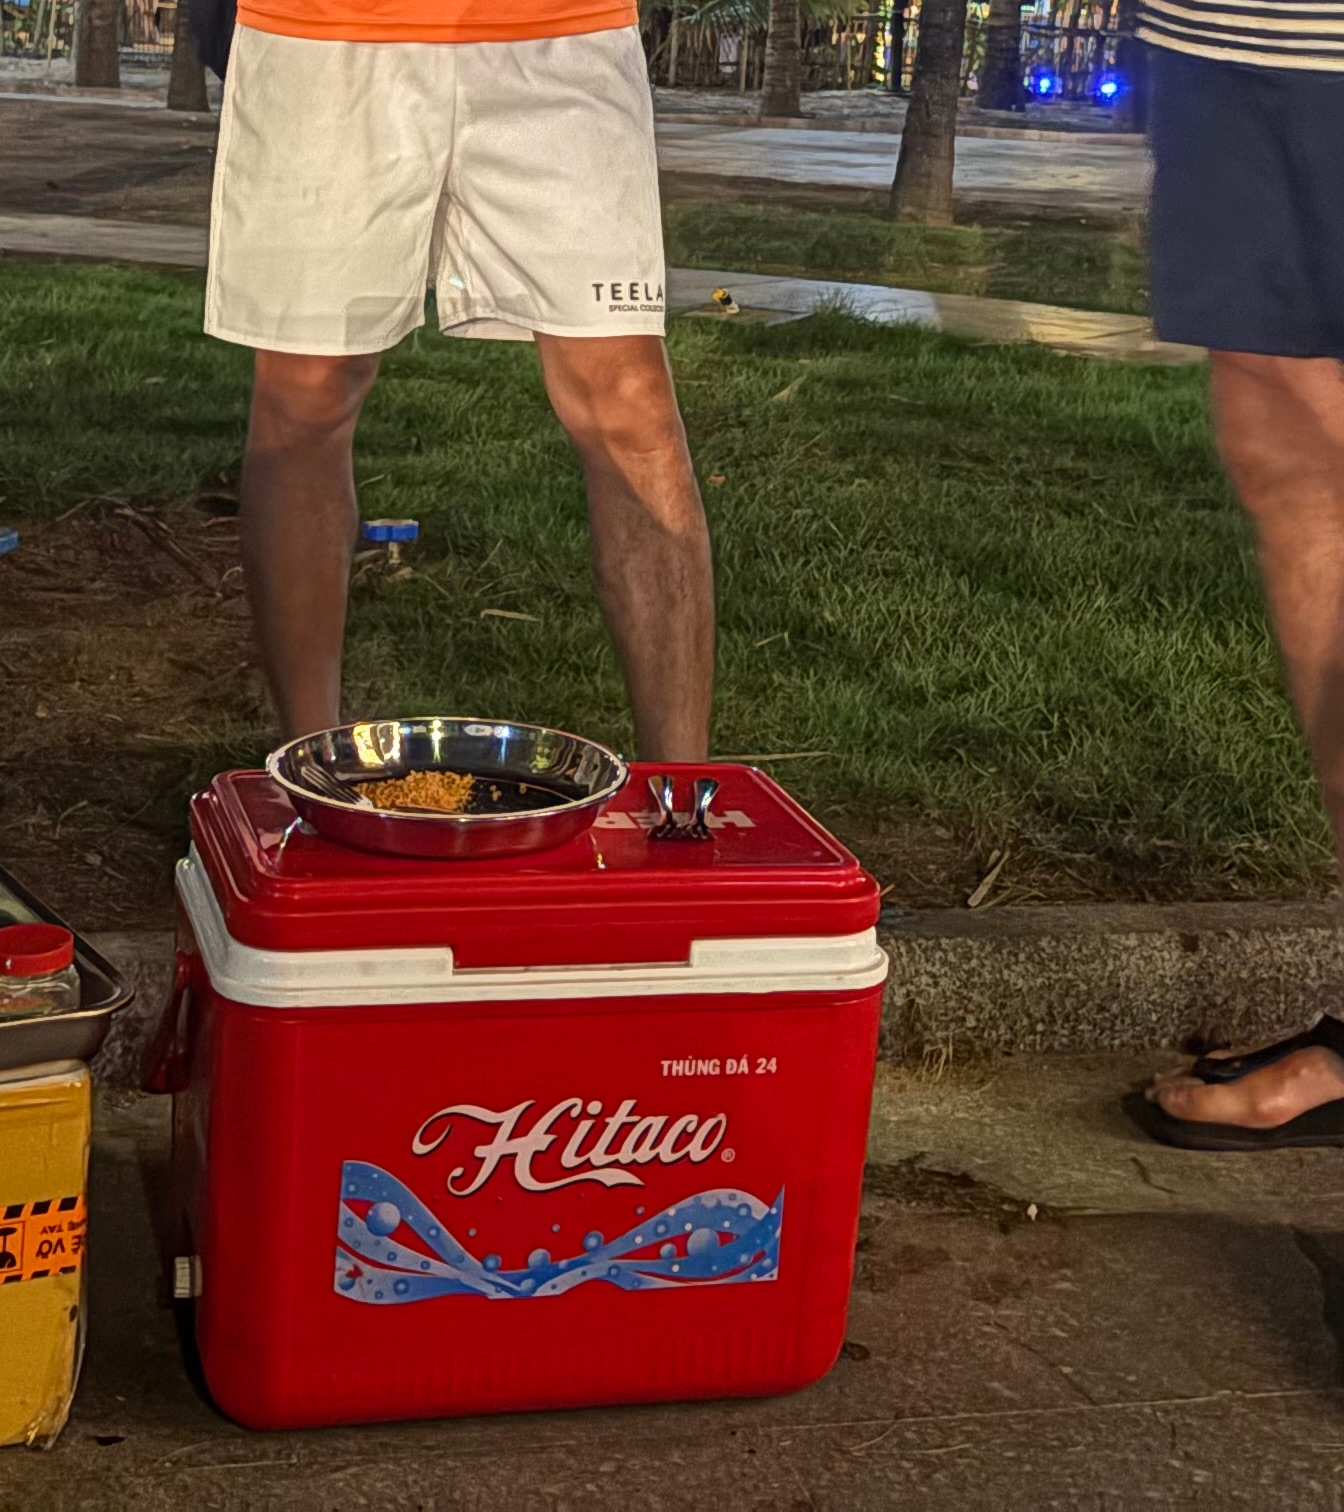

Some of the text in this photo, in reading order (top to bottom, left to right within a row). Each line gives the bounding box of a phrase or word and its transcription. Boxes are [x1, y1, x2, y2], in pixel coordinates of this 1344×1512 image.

[660, 1053, 778, 1077] THÙNG ĐÁ 24
[411, 1096, 728, 1196] Hitaco
[40, 1223, 65, 1235] TAY
